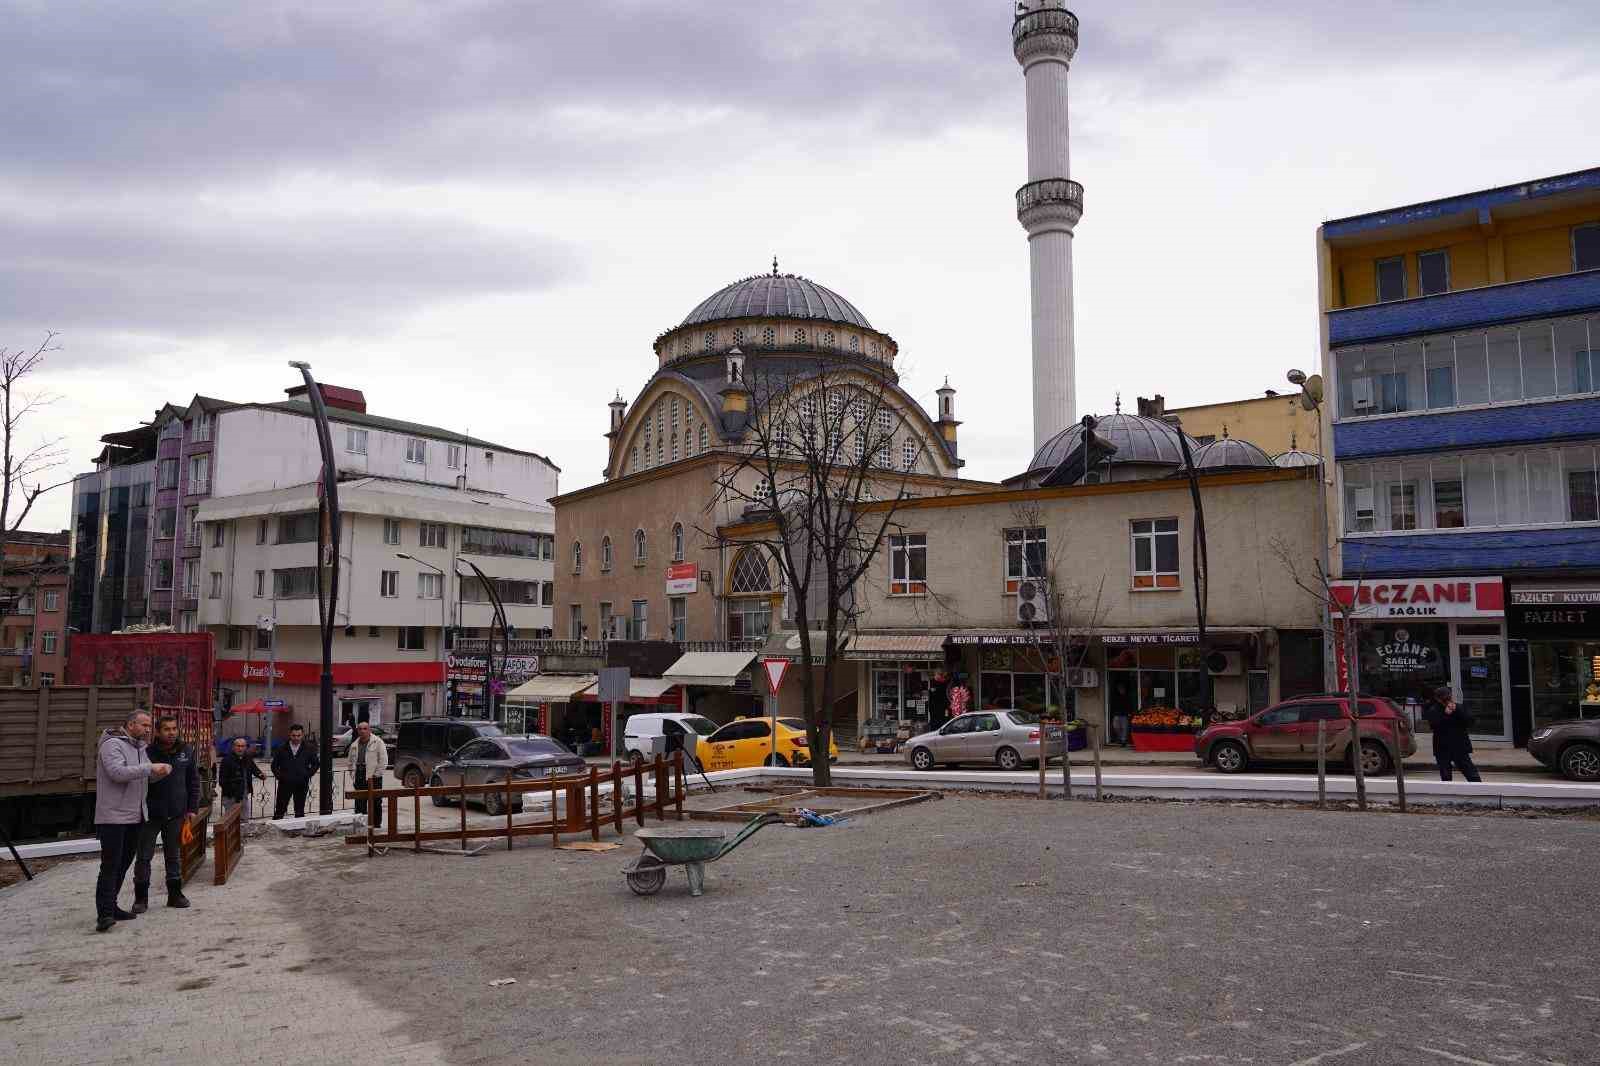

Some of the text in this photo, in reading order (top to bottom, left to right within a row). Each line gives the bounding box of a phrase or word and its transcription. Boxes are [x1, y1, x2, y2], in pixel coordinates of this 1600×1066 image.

[1358, 583, 1472, 604] ECZANE
[1389, 606, 1437, 616] SAĞLIK
[1376, 643, 1431, 657] ECZANE
[456, 656, 488, 668] vodafone
[1385, 656, 1418, 665] SAĞLIK
